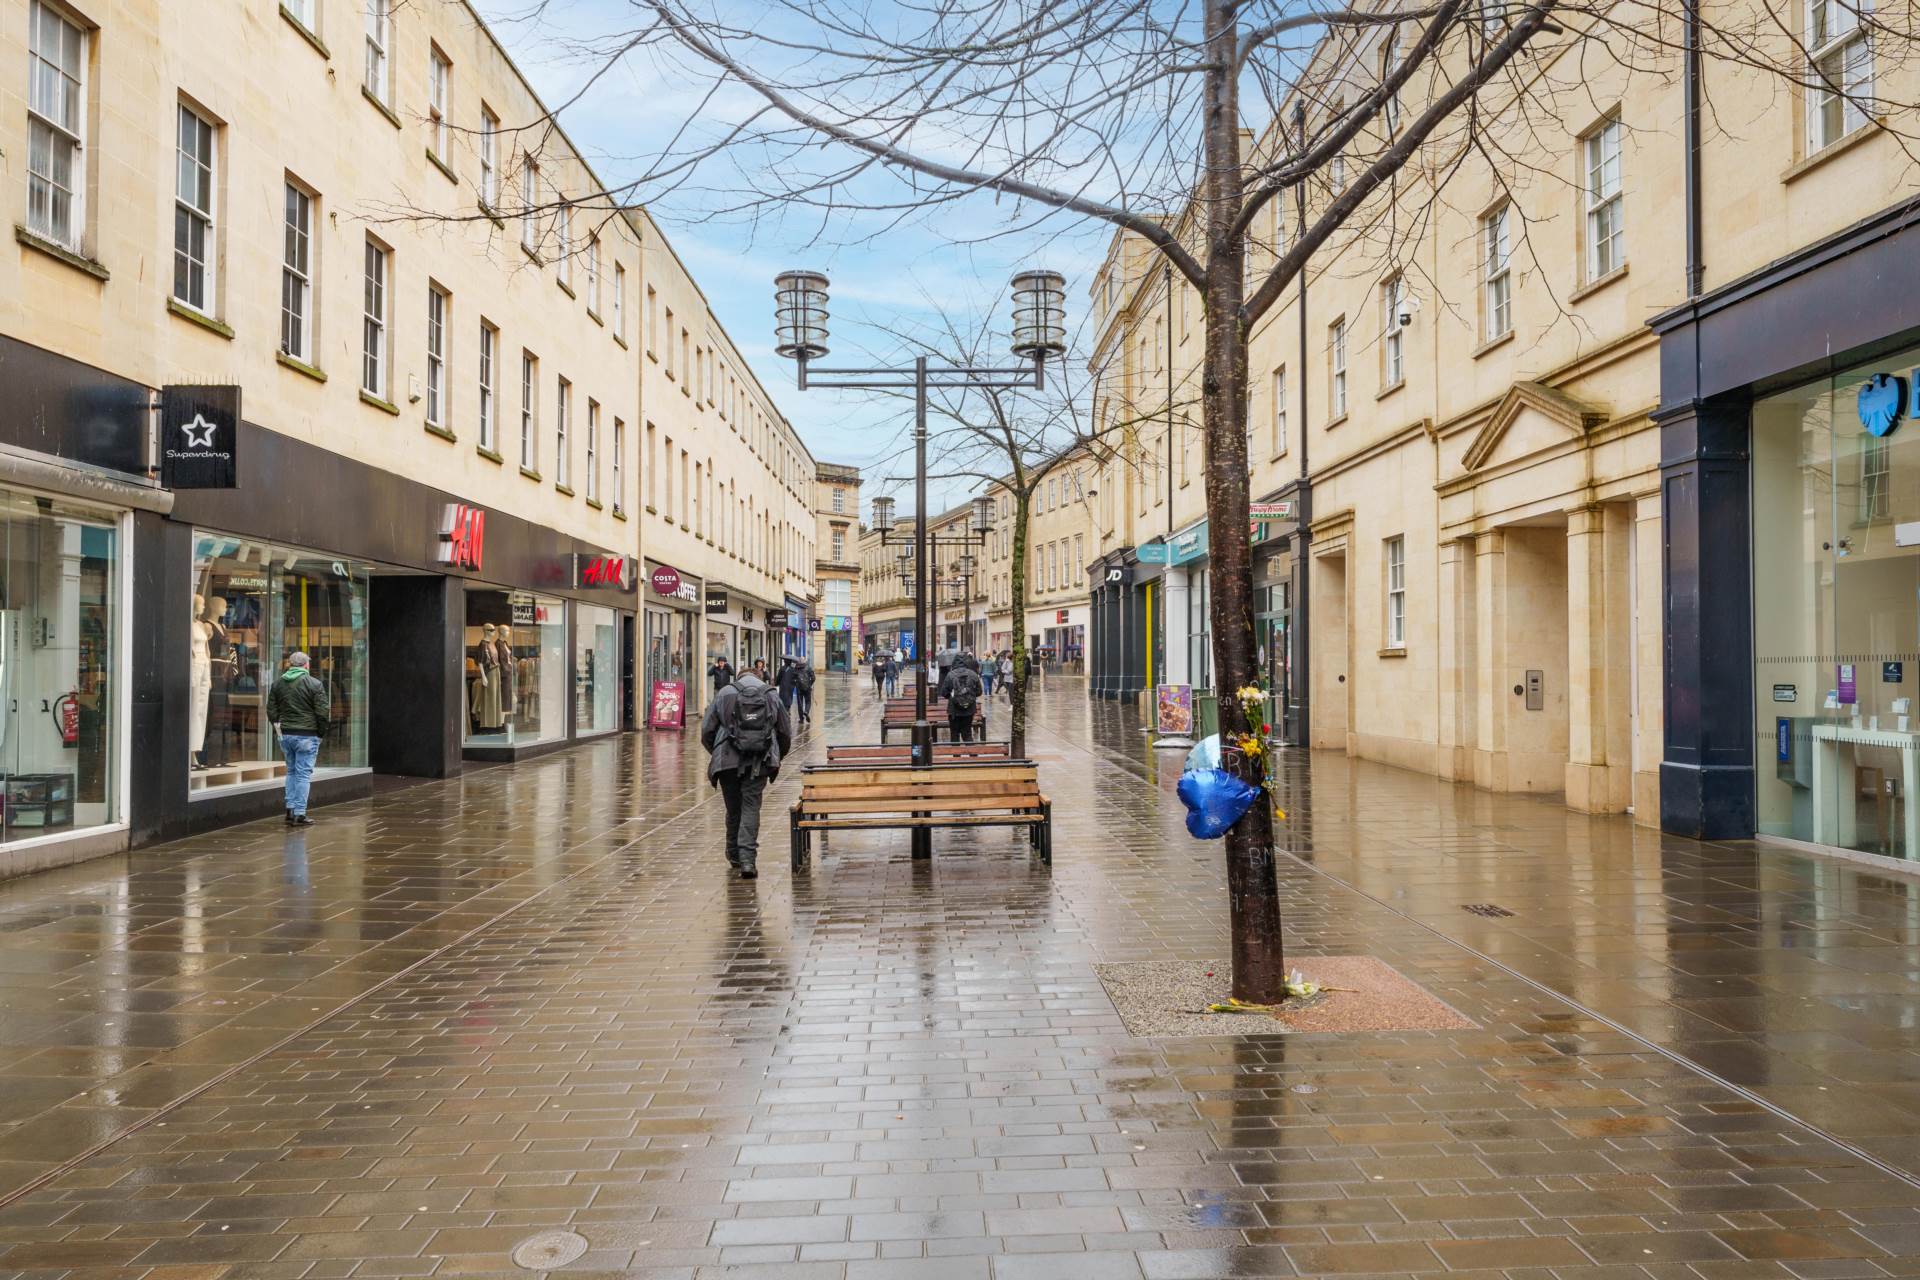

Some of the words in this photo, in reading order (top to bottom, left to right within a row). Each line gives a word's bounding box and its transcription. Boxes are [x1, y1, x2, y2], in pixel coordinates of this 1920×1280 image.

[166, 450, 230, 459] Superdrug
[443, 503, 484, 571] H&M
[583, 557, 624, 588] H&M
[1106, 569, 1122, 581] JD
